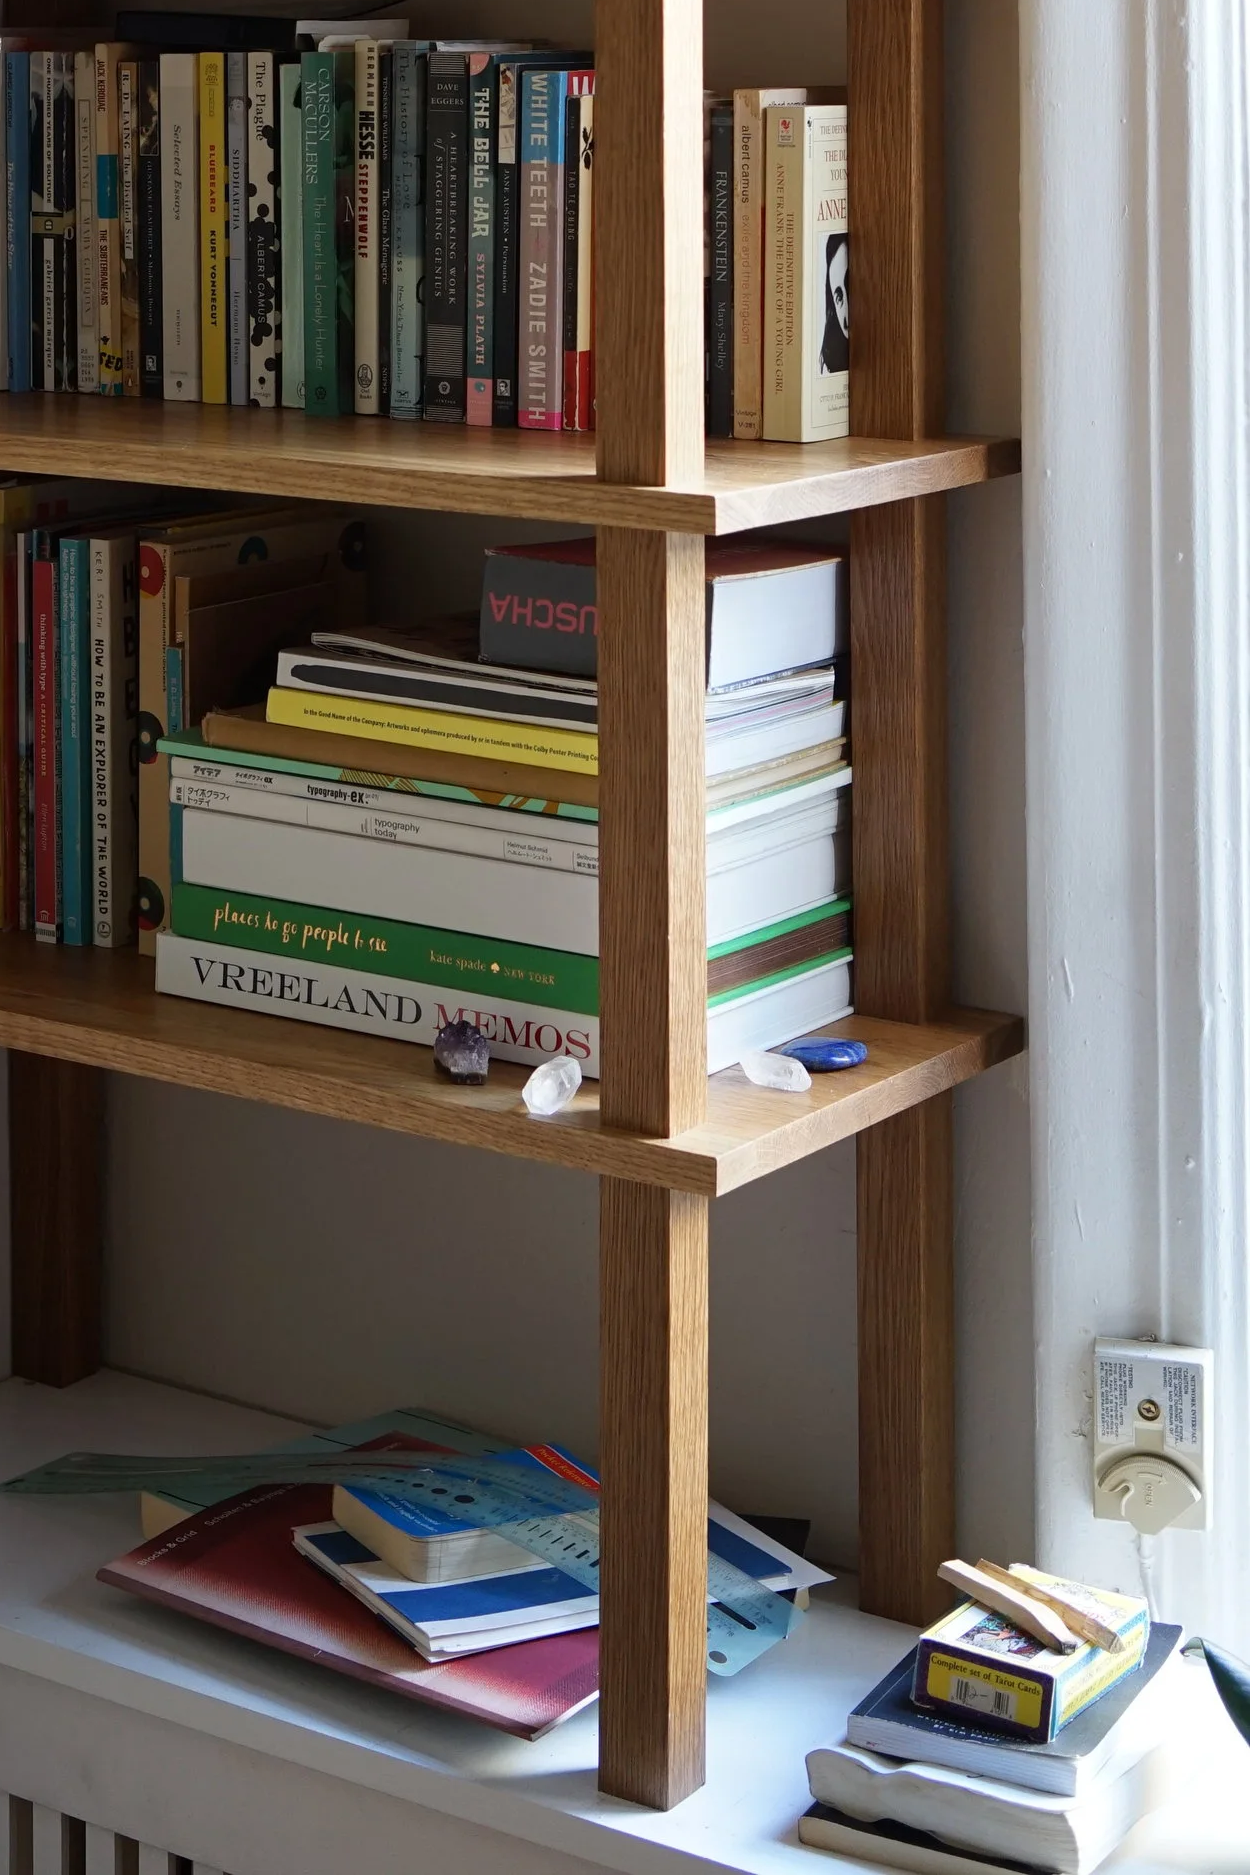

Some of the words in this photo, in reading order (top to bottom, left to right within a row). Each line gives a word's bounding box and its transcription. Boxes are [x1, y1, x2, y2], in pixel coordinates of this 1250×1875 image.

[97, 58, 106, 79] JACK
[255, 61, 266, 88] The
[366, 46, 376, 107] HERMANN
[436, 82, 460, 92] DAVE
[97, 79, 107, 112] KEROUAC
[253, 93, 266, 141] Plague
[317, 67, 330, 142] CARSON
[430, 97, 465, 107] EGGERS
[473, 86, 491, 131] THE
[529, 73, 548, 147] WHITE
[172, 123, 183, 176] Selected
[304, 80, 318, 185] McCULLERS
[358, 110, 375, 160] HESSE
[741, 125, 752, 160] albert
[208, 143, 217, 213] BLUEBEARD
[472, 136, 490, 189] BELL
[740, 163, 751, 204] camus
[776, 163, 785, 193] ANNE
[124, 180, 132, 224] Divided
[172, 178, 183, 221] Essays
[232, 148, 241, 231] SIDDHARTHA
[313, 196, 327, 219] The
[357, 163, 369, 259] STEPPENWOLF
[434, 156, 444, 241] STAGGERING
[448, 146, 458, 261] HEARTBREAKING
[529, 156, 548, 227] TEETH
[816, 197, 847, 222] ANNE
[99, 229, 108, 244] THE
[471, 195, 490, 238] JAR
[714, 170, 728, 283] FRANKENSTEIN
[741, 214, 752, 244] exile
[209, 229, 217, 261] KURT
[256, 234, 265, 279] ALBERT
[314, 221, 327, 257] Heart
[100, 244, 109, 306] SUBTERRANEANS
[434, 247, 443, 298] GENIUS
[448, 266, 458, 306] WORK
[475, 252, 486, 309] SYLVIA
[501, 244, 510, 295] Persuasion
[775, 261, 784, 296] DIARY
[785, 235, 795, 299] DEFINITIVE
[209, 263, 218, 327] VONNEGUT
[256, 282, 266, 324] CAMUS
[312, 284, 328, 325] Lonely
[528, 261, 547, 334] ZADIE
[715, 300, 727, 329] Mary
[475, 313, 485, 366] PLATH
[738, 293, 752, 345] kingdom
[785, 300, 795, 347] EDITION
[315, 328, 328, 371] Hunter
[715, 331, 728, 372] Shelley
[775, 326, 784, 368] YOUNG
[527, 344, 547, 421] SMITH
[94, 550, 104, 582] KERI
[38, 612, 47, 650] thinking
[94, 592, 104, 628] SMITH
[487, 591, 598, 637] USCHA
[94, 638, 105, 667] HOW
[95, 690, 105, 707] BE
[95, 712, 105, 735] AN
[332, 712, 346, 721] Name
[361, 717, 386, 728] Company:
[386, 721, 410, 732] Artworks
[420, 727, 446, 738] ephemera
[446, 731, 471, 742] produced
[567, 749, 590, 762] Printing
[95, 739, 107, 807] EXPLORER
[96, 812, 107, 830] OF
[374, 817, 421, 834] typography
[374, 827, 398, 840] today
[97, 836, 108, 861] THE
[97, 866, 108, 915] WORLD
[213, 901, 260, 932] places
[301, 921, 349, 952] people
[368, 936, 388, 952] see
[429, 950, 453, 966] kate
[454, 955, 487, 974] spade
[503, 966, 525, 981] NEW
[528, 973, 556, 986] YORK
[189, 955, 423, 1026] VREELAND
[1189, 1373, 1198, 1408] NETWORK
[1190, 1408, 1198, 1445] INTERFACE
[535, 1446, 562, 1468] Pocket
[136, 1546, 169, 1567] Blocks
[175, 1529, 199, 1544] Grid
[203, 1502, 244, 1527] Scholten
[930, 1655, 968, 1674] Complete
[969, 1668, 982, 1676] set
[994, 1675, 1016, 1690] Tarot
[1017, 1681, 1042, 1697] Cards
